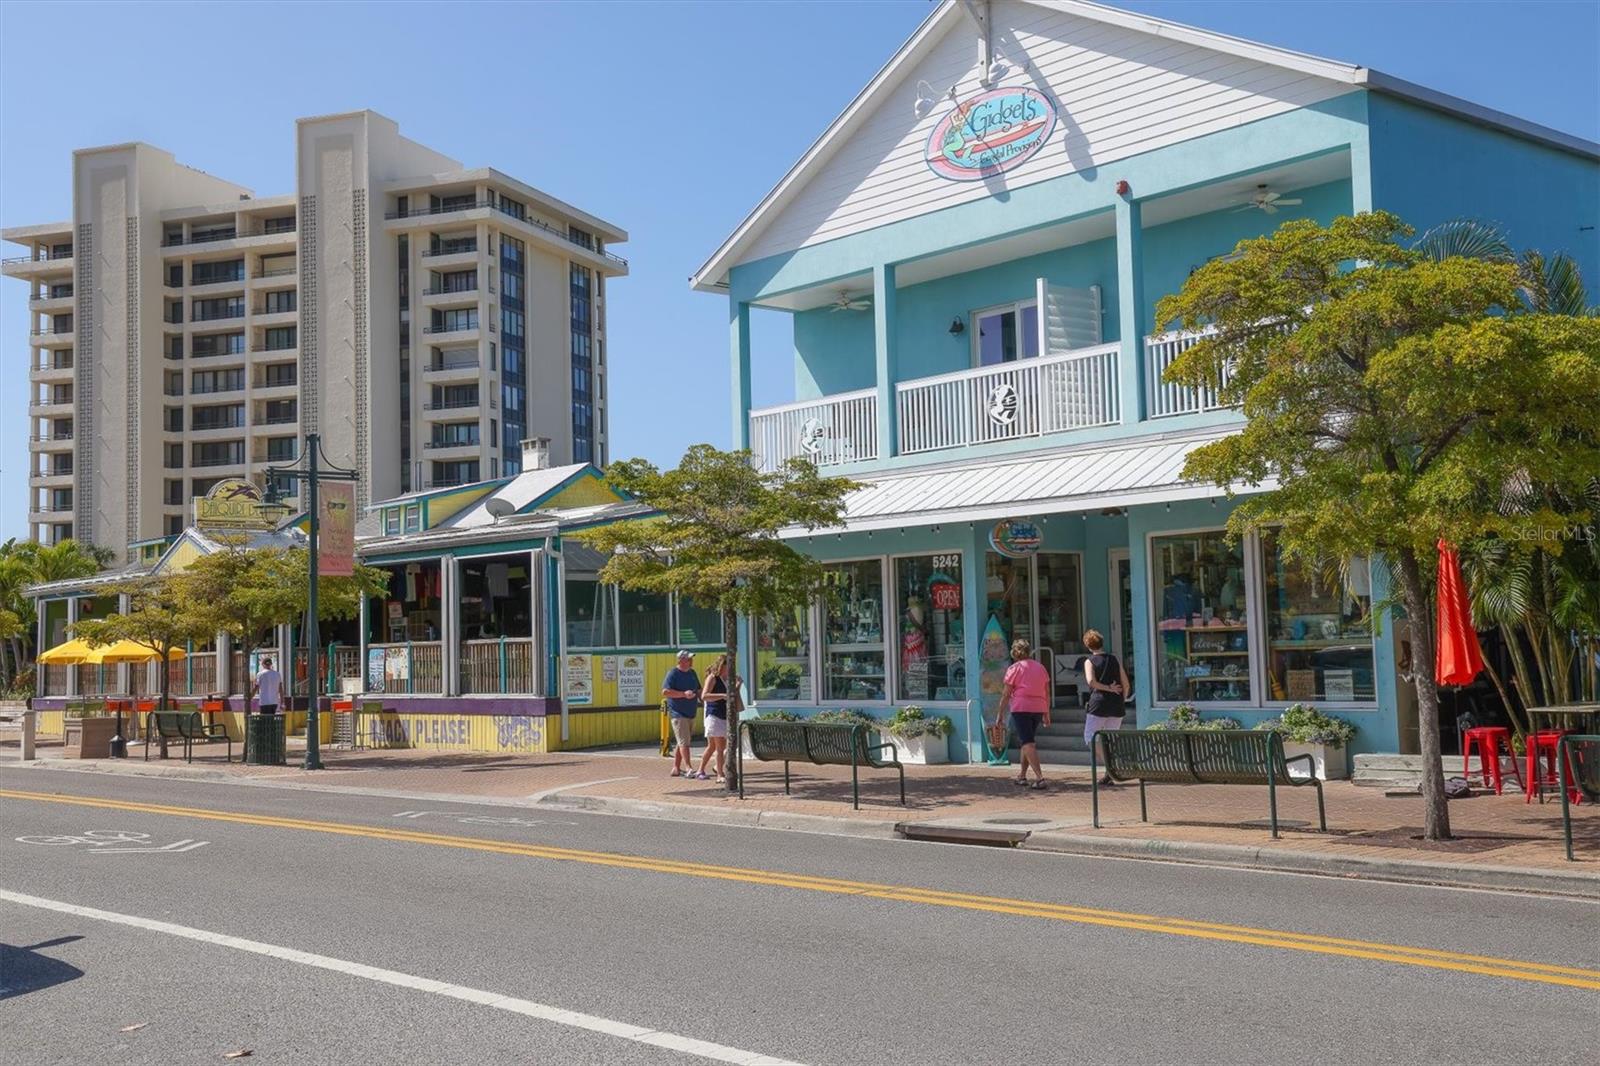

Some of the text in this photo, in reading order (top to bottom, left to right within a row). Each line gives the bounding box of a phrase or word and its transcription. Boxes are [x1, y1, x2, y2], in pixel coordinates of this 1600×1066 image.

[932, 554, 959, 568] 5242
[936, 590, 959, 607] OPEN
[621, 677, 642, 685] PARKING
[416, 719, 471, 745] PLEASE!
